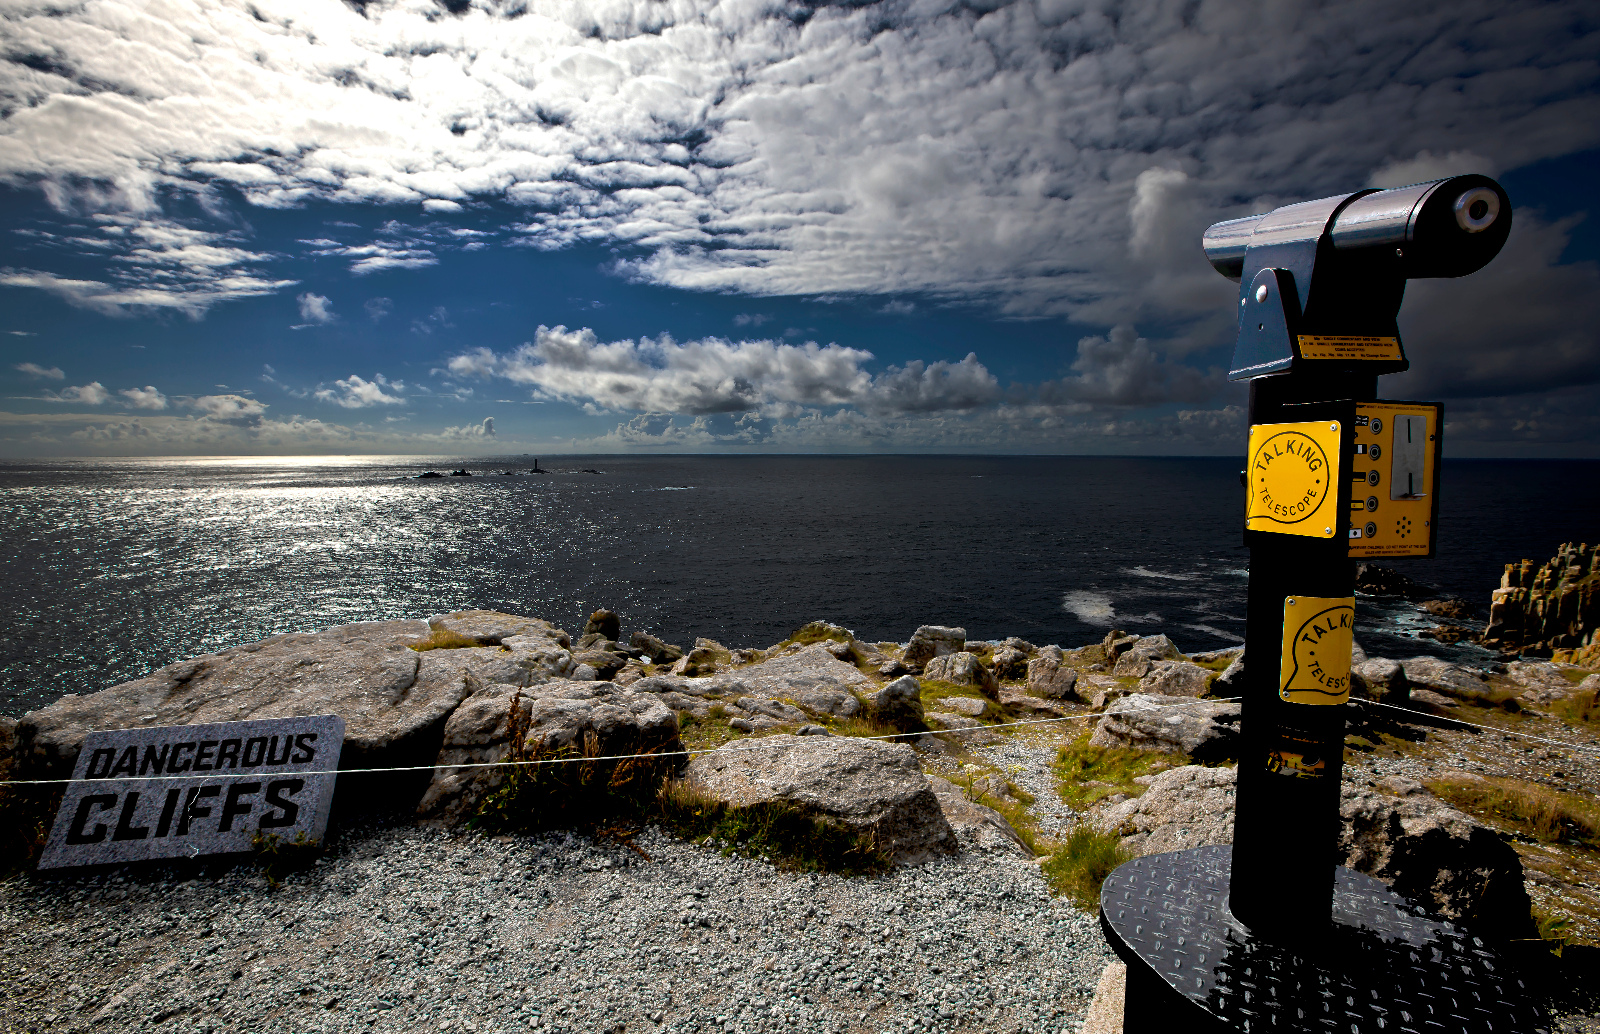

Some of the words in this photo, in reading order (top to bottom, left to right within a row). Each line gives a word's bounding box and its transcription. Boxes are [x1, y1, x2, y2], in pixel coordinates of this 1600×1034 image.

[1255, 439, 1323, 473] TALKING
[1259, 487, 1318, 517] TELESCOPE
[1301, 613, 1353, 645] TALKI
[1307, 660, 1350, 689] TELESCO
[84, 732, 318, 780] DANGEROUS
[65, 778, 305, 846] CLIFFS
